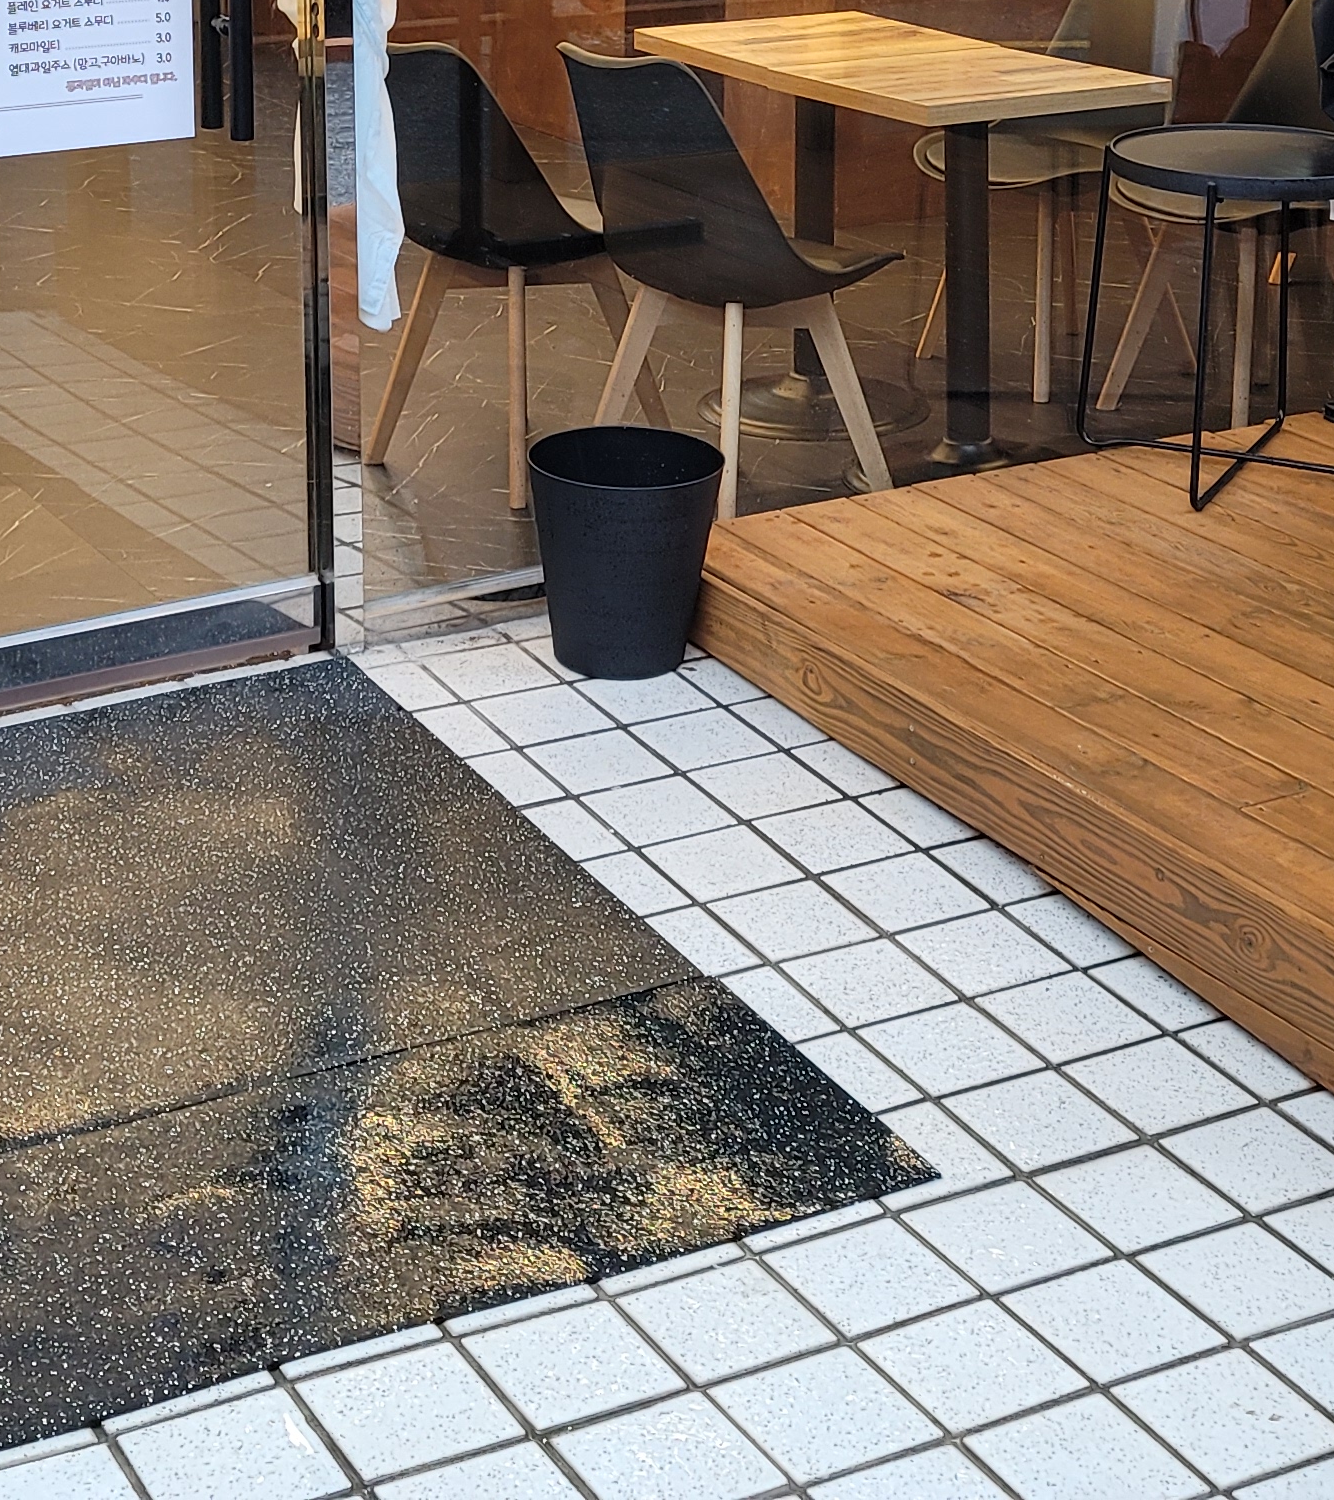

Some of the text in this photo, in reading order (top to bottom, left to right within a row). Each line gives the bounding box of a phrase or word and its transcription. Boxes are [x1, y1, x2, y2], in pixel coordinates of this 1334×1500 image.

[7, 0, 39, 15] 플레인
[51, 16, 81, 29] 요거트
[84, 14, 114, 27] 스무디
[155, 11, 171, 23] 5.0
[156, 32, 171, 43] 3.0
[8, 59, 71, 77] 열대과일주스
[156, 52, 172, 64] 3.0
